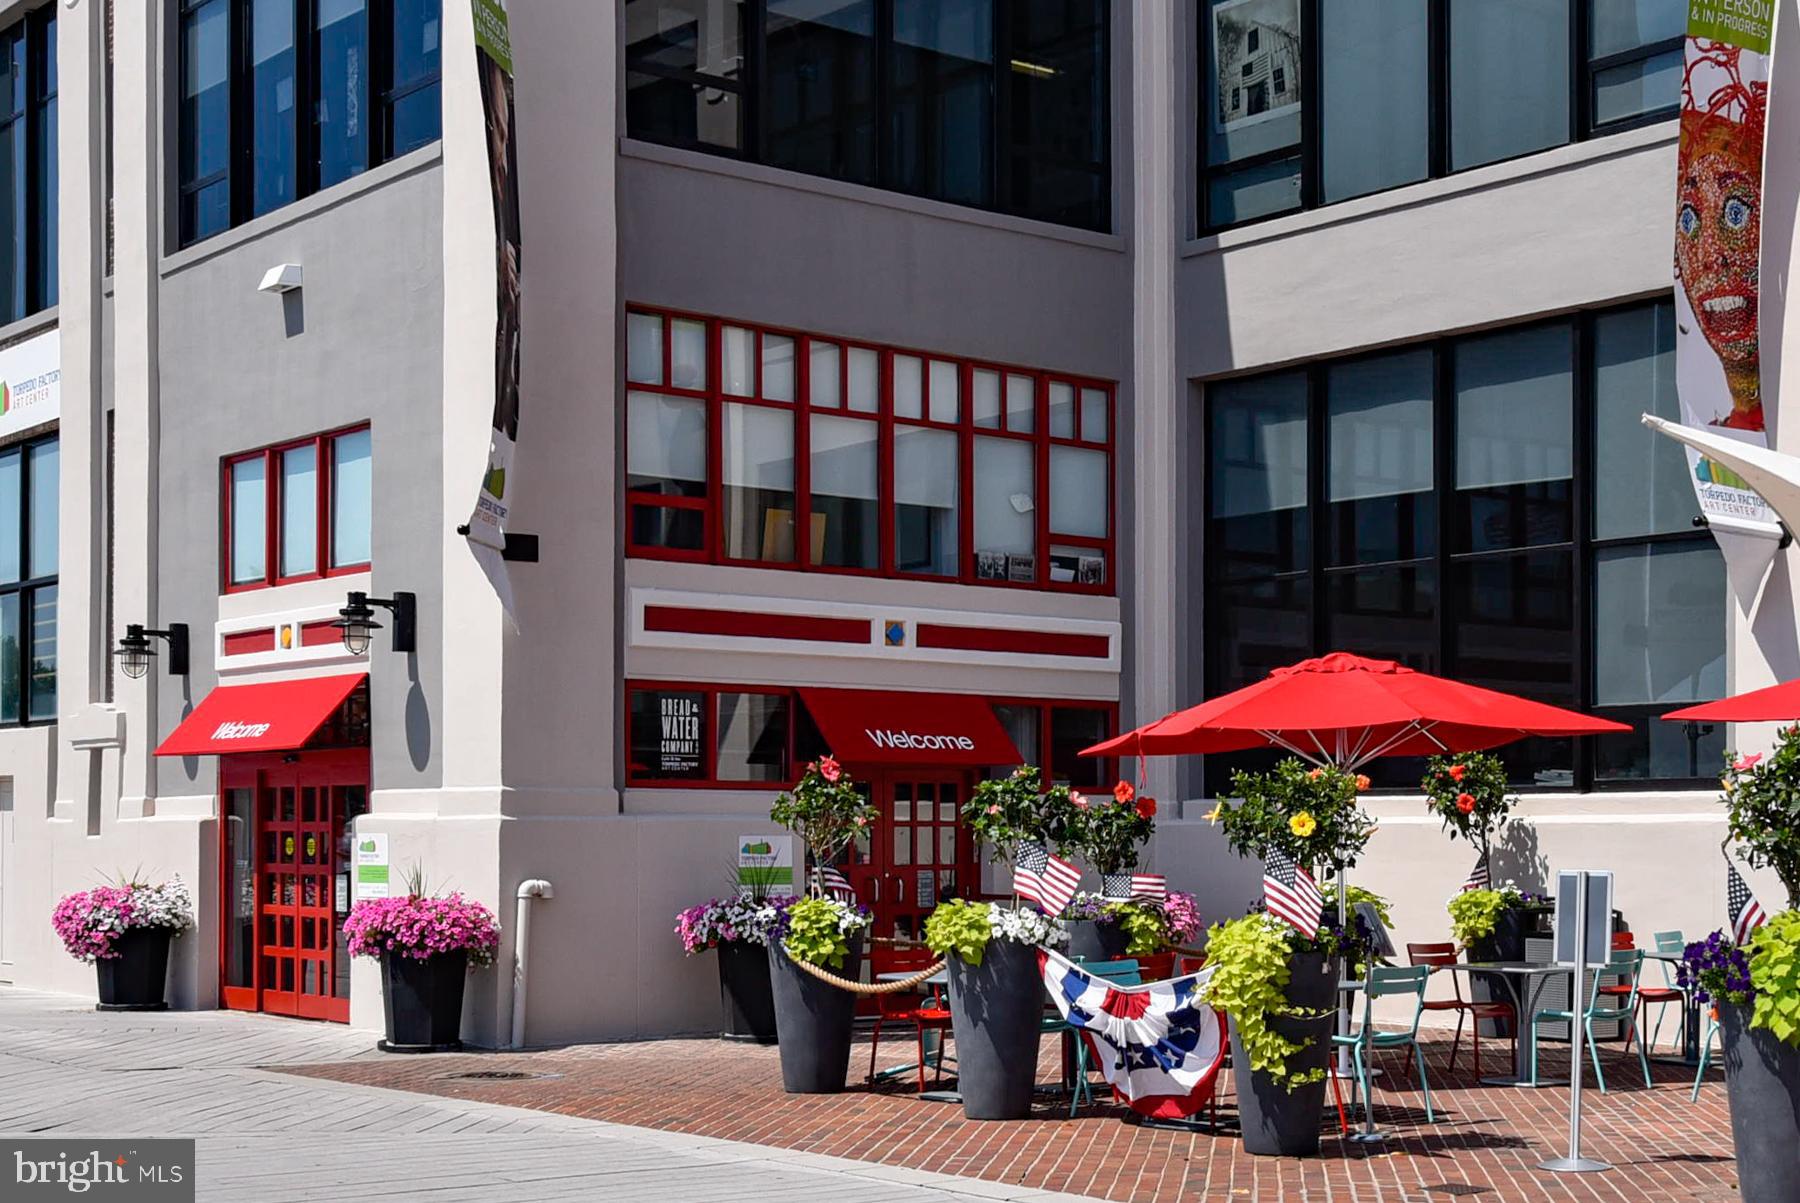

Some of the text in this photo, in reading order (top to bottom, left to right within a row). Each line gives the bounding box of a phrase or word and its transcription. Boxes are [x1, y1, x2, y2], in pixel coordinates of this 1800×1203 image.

[1691, 7, 1768, 39] & IN PROGRESS
[1699, 489, 1766, 508] TORPEDO FACTOR
[1703, 500, 1756, 516] ART CENTER
[661, 698, 699, 716] BREAD &
[210, 720, 271, 740] Welcome
[661, 716, 699, 740] WATER
[661, 740, 693, 753] COMPANY
[864, 729, 975, 750] Welcome
